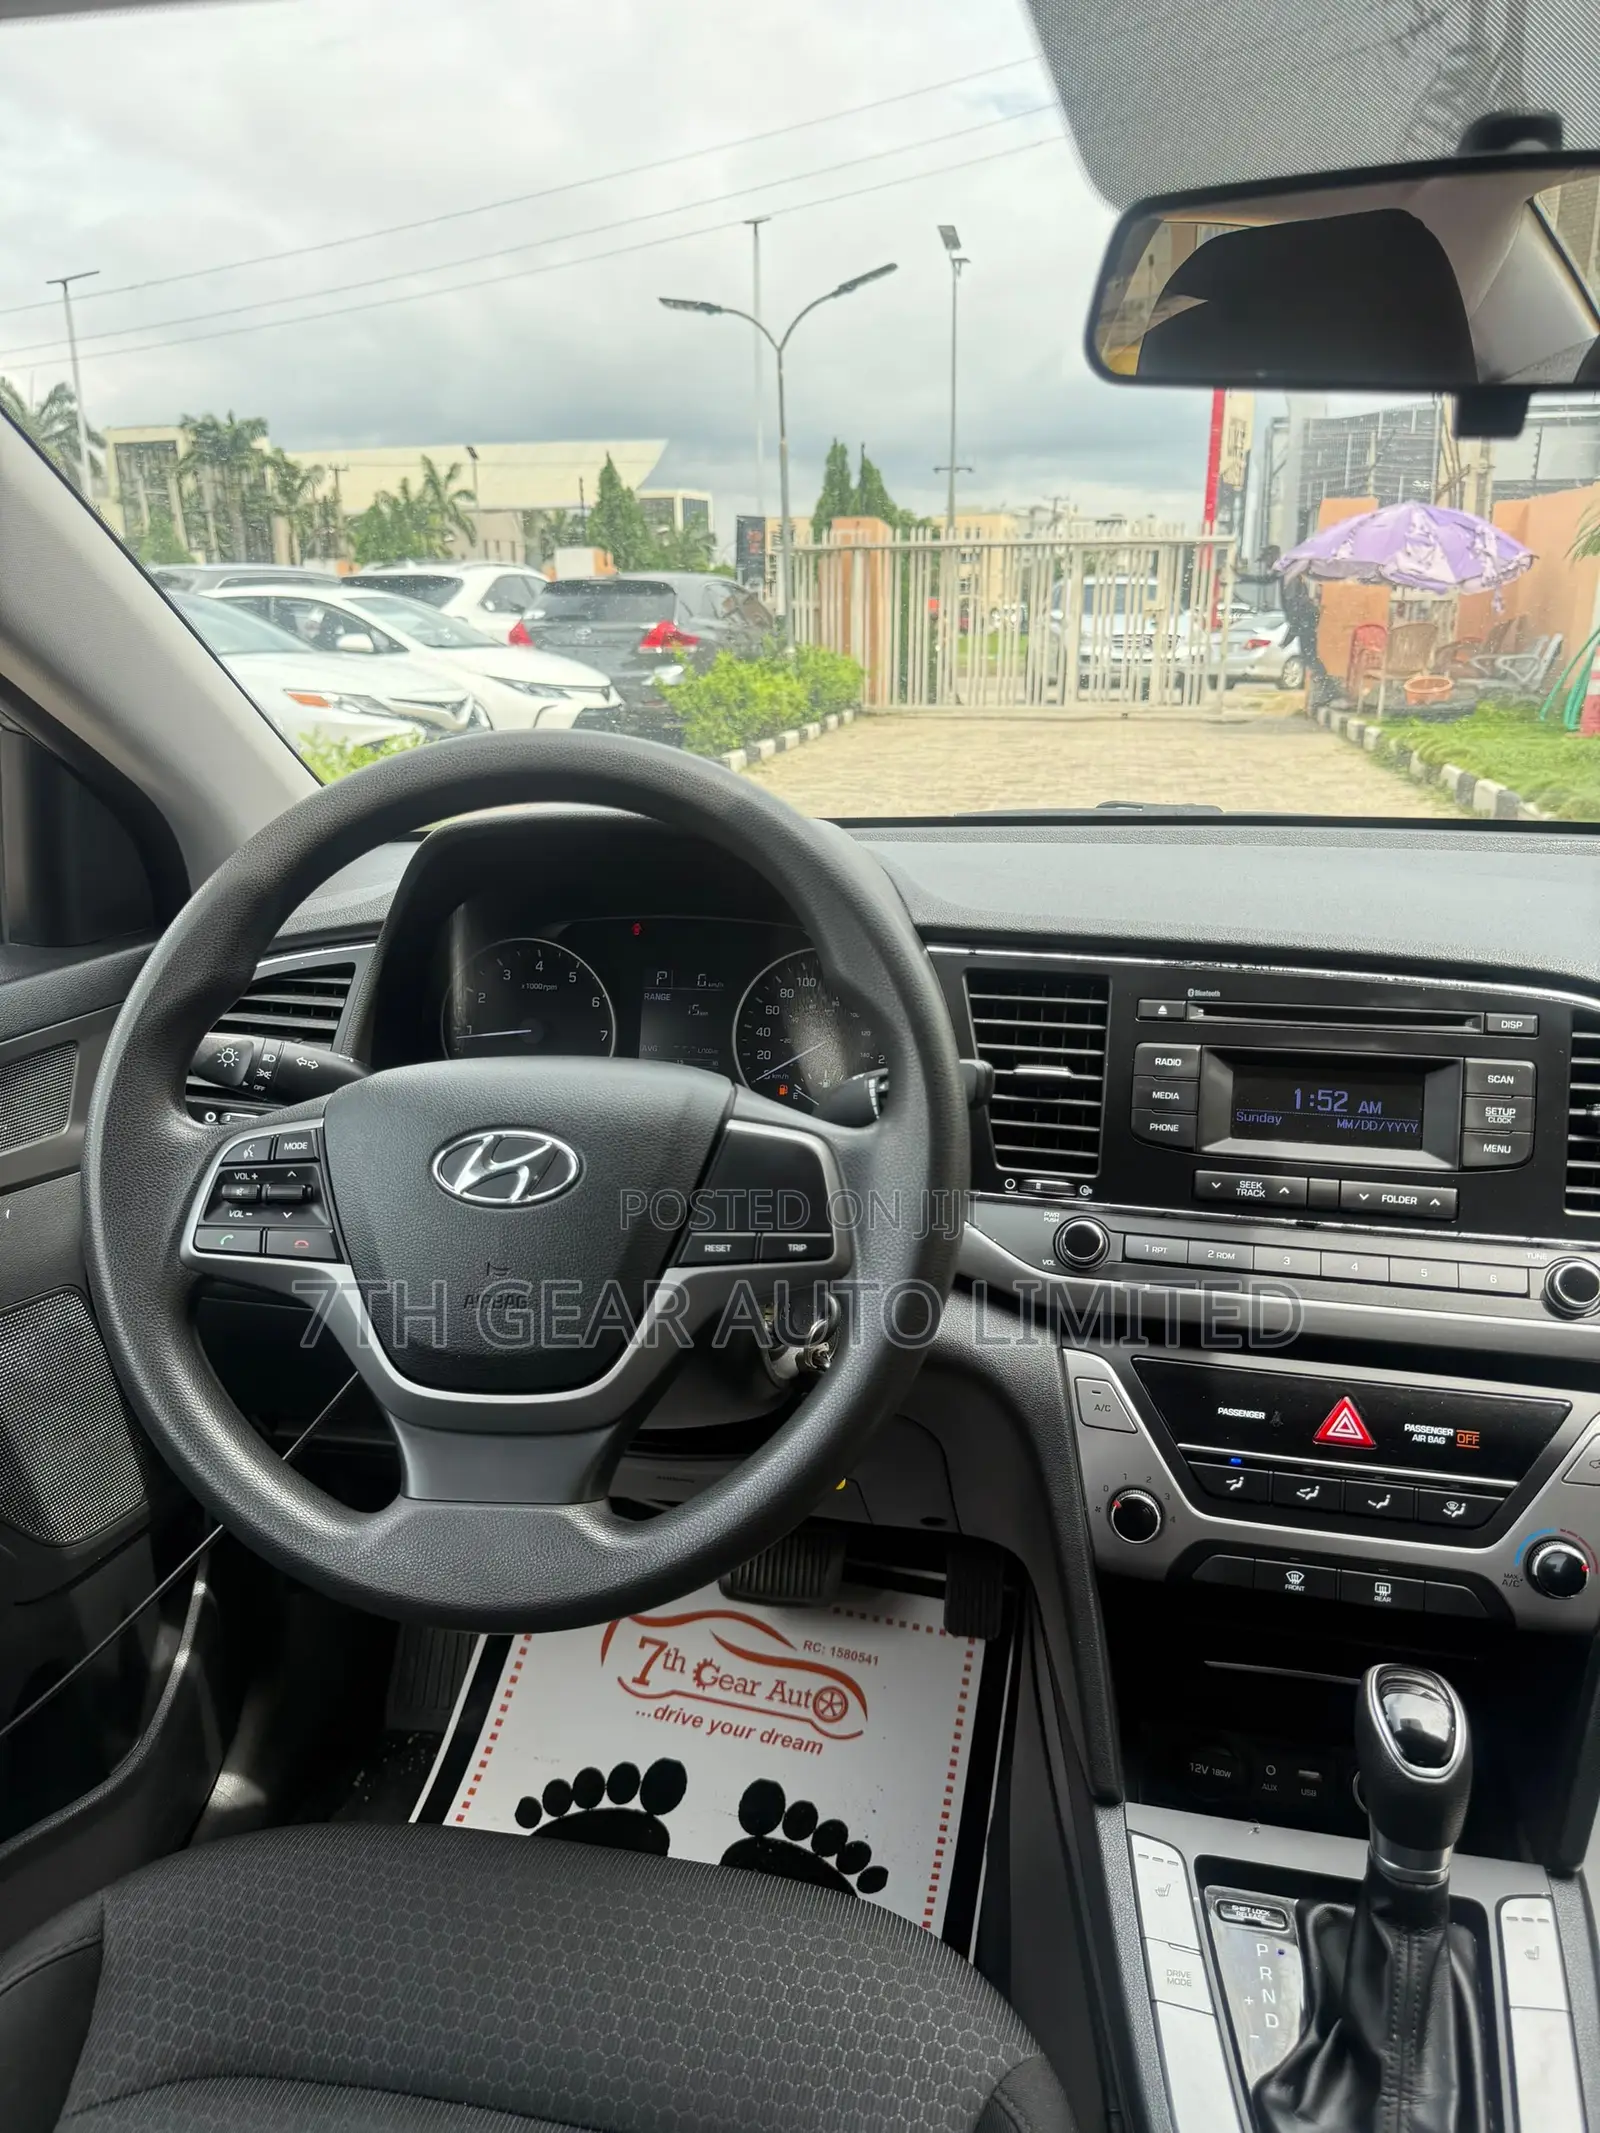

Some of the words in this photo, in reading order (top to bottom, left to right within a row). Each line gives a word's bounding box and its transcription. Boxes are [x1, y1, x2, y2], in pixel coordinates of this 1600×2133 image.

[535, 961, 543, 972] 4
[503, 969, 511, 980] 3
[568, 972, 577, 983] 5
[656, 971, 668, 985] P
[797, 978, 816, 987] 100
[644, 993, 671, 1001] RANGE
[780, 988, 794, 998] 80
[1194, 989, 1221, 998] Bluetooth
[478, 993, 486, 1004] 2
[592, 997, 600, 1008] 6
[765, 1005, 780, 1015] 60
[1501, 1020, 1523, 1029] DISP
[600, 1031, 608, 1041] 7
[756, 1028, 771, 1037] 40
[757, 1050, 771, 1060] 20
[1155, 1058, 1182, 1067] RADIO
[772, 1073, 789, 1081] km/h
[1487, 1075, 1514, 1085] SCAN
[253, 1084, 266, 1092] OFF
[793, 1090, 799, 1100] E
[1152, 1091, 1180, 1100] MEDIA
[1294, 1088, 1348, 1113] 1:52
[1358, 1101, 1382, 1115] AM
[1485, 1107, 1516, 1117] SETUP
[1236, 1111, 1282, 1126] Sunday
[1337, 1119, 1418, 1133] MM/DD/YYYY
[1488, 1116, 1512, 1124] CLOCK
[1150, 1123, 1179, 1132] PHONE
[284, 1142, 308, 1150] MODE
[1483, 1143, 1511, 1154] MENU
[1239, 1180, 1263, 1190] SEEK
[1236, 1188, 1266, 1198] TRACK
[1381, 1194, 1418, 1205] FOLDER
[704, 1244, 731, 1253] RESET
[788, 1243, 807, 1252] TRIP
[1144, 1244, 1149, 1252] 1
[1152, 1246, 1167, 1254] RPT
[1207, 1250, 1214, 1258] 2
[1216, 1251, 1235, 1260] RDM
[1526, 1252, 1548, 1261] TUNE
[1283, 1257, 1291, 1266] 3
[1351, 1262, 1358, 1272] 4
[1420, 1268, 1428, 1278] 5
[1489, 1274, 1497, 1284] 6
[1094, 1404, 1111, 1412] A/C
[1217, 1407, 1266, 1420] PASSENGER
[1404, 1423, 1454, 1436] PASSENGER
[1412, 1433, 1427, 1443] AIR
[1428, 1434, 1446, 1445] BAG
[1457, 1432, 1480, 1446] OFF
[1123, 1473, 1128, 1481] 1
[1146, 1476, 1152, 1484] 2
[1284, 1584, 1305, 1592] FRONT
[1501, 1579, 1520, 1588] A/C
[1374, 1595, 1392, 1603] REAR
[803, 1640, 826, 1655] RC:
[830, 1646, 879, 1666] 1580541
[632, 1636, 686, 1686] 7th
[692, 1658, 762, 1696] Gear
[706, 1719, 756, 1740] your
[760, 1728, 823, 1755] dream
[1190, 1762, 1209, 1775] 12V
[1211, 1767, 1232, 1778] 180W
[1261, 1783, 1278, 1791] AUX
[1300, 1788, 1317, 1797] USB
[1231, 1904, 1251, 1913] SHIFT
[1251, 1907, 1271, 1917] LOCK
[1256, 1943, 1268, 1957] P
[1166, 1969, 1191, 1979] DRIVE
[1259, 1966, 1273, 1981] R
[1167, 1977, 1192, 1987] MODE
[1262, 1988, 1276, 2004] N
[1265, 2013, 1279, 2028] D
